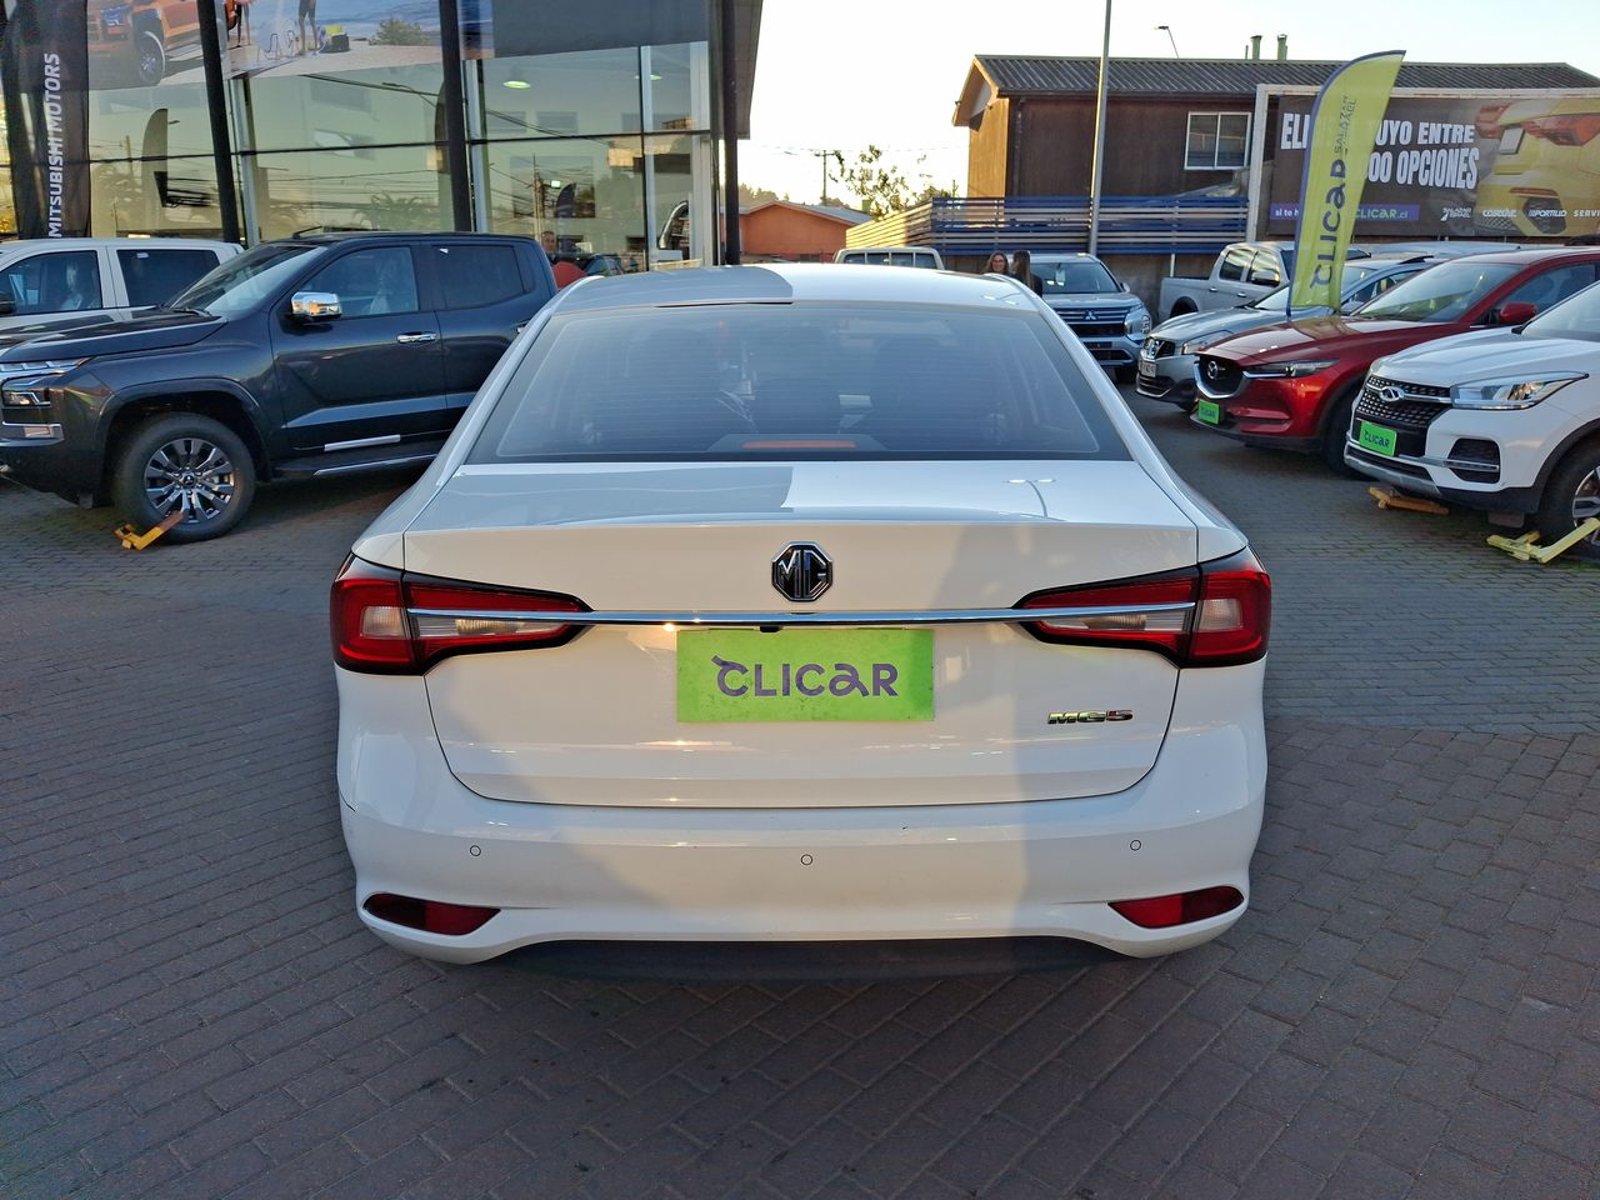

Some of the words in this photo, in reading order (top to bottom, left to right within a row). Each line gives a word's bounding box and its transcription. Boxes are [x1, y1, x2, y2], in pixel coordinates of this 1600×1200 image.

[43, 52, 63, 133] MOTORS
[1281, 113, 1311, 149] ELI
[1375, 119, 1413, 146] UYO
[1417, 121, 1476, 145] ENTRE
[48, 138, 64, 238] MITSUBISHI
[1368, 151, 1393, 183] 00
[1396, 147, 1480, 190] OPCIONES
[774, 544, 830, 599] MG
[1048, 709, 1133, 724] MG5
